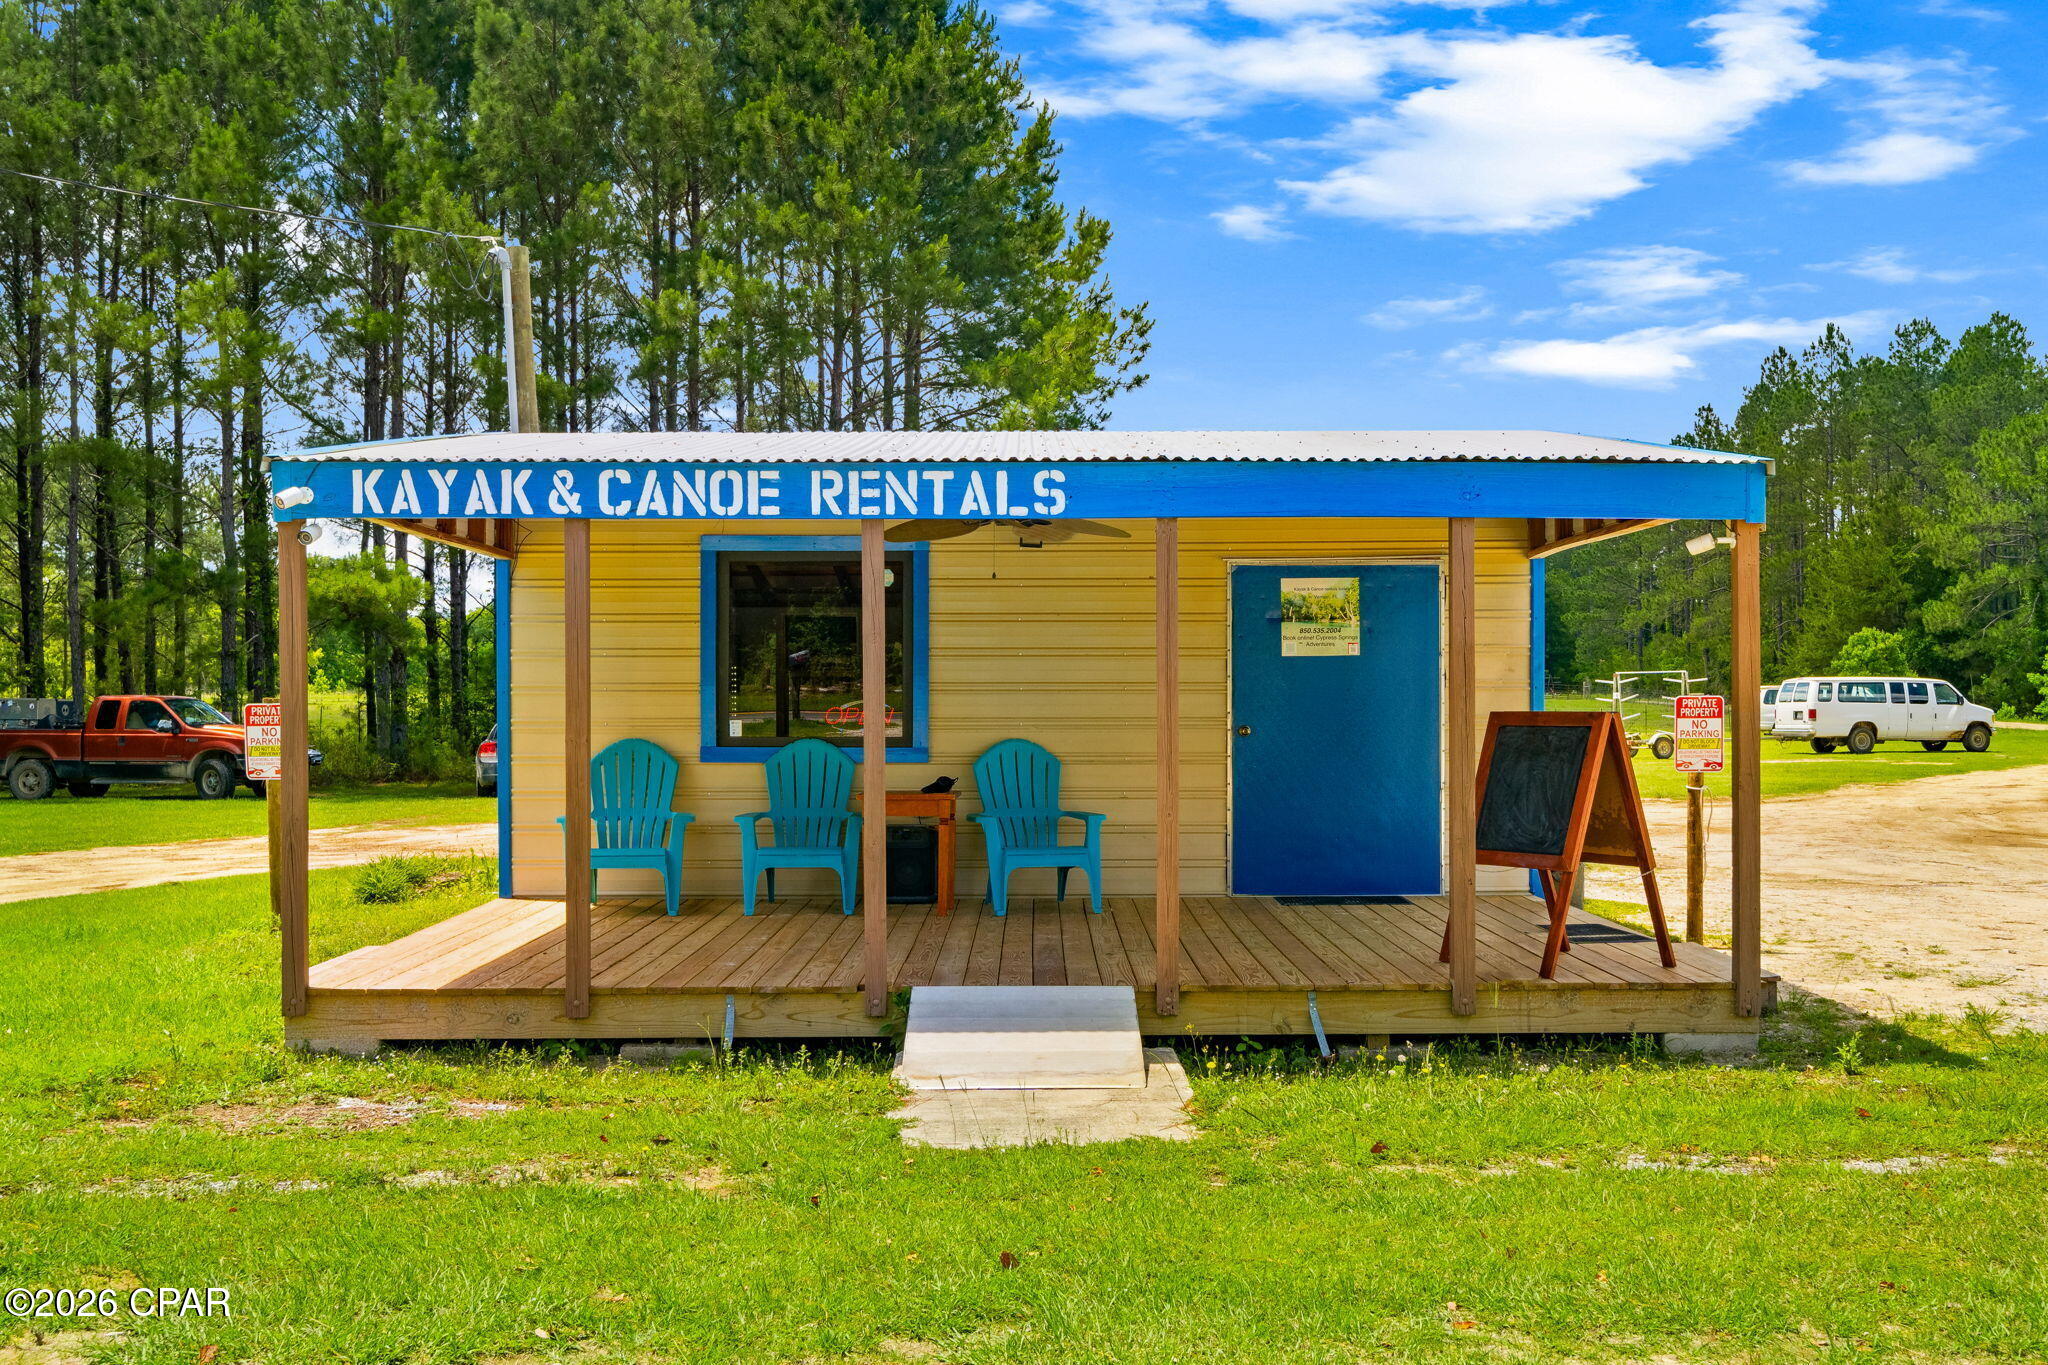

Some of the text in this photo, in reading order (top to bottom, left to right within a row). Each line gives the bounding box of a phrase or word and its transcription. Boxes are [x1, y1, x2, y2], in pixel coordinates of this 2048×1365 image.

[351, 469, 1067, 516] KAYAK & CANOE RENTALS
[1682, 699, 1718, 708] PRIVATE
[251, 707, 281, 715] PRIVAT
[1680, 708, 1719, 717] PROPERTY
[249, 716, 280, 724] PROPER
[1691, 719, 1708, 729] NO
[261, 727, 278, 737] NO
[1680, 730, 1720, 738] PARKING
